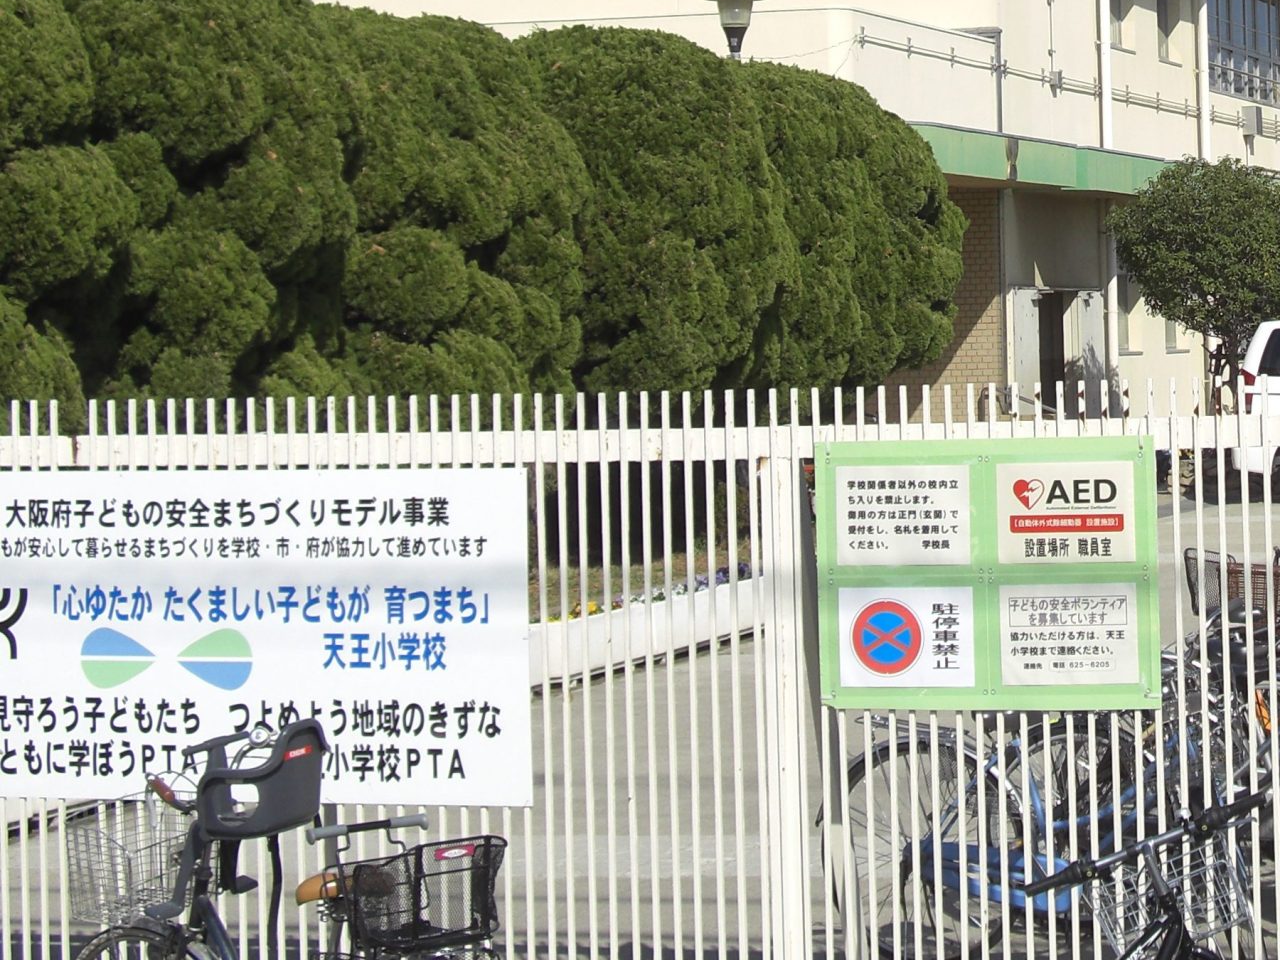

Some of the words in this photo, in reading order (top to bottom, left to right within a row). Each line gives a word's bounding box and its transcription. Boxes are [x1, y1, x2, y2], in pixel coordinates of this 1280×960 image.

[1045, 479, 1117, 504] AED
[5, 496, 450, 528] 大阪府子どもの安全まちづくりモデル事業
[0, 536, 488, 559] もが安心して暮らせるまちづくりを学校・市・府が協力して進めています
[922, 540, 950, 550] 学校長
[1024, 537, 1070, 557] 設置場所
[1078, 537, 1112, 557] 職員室
[163, 585, 371, 623] たくましい子どもが
[1010, 598, 1126, 612] 子どもの安全ボランティア
[931, 603, 960, 669] 駐停車禁止
[323, 631, 448, 671] 天王小学校
[320, 743, 466, 782] 小学校PTA
